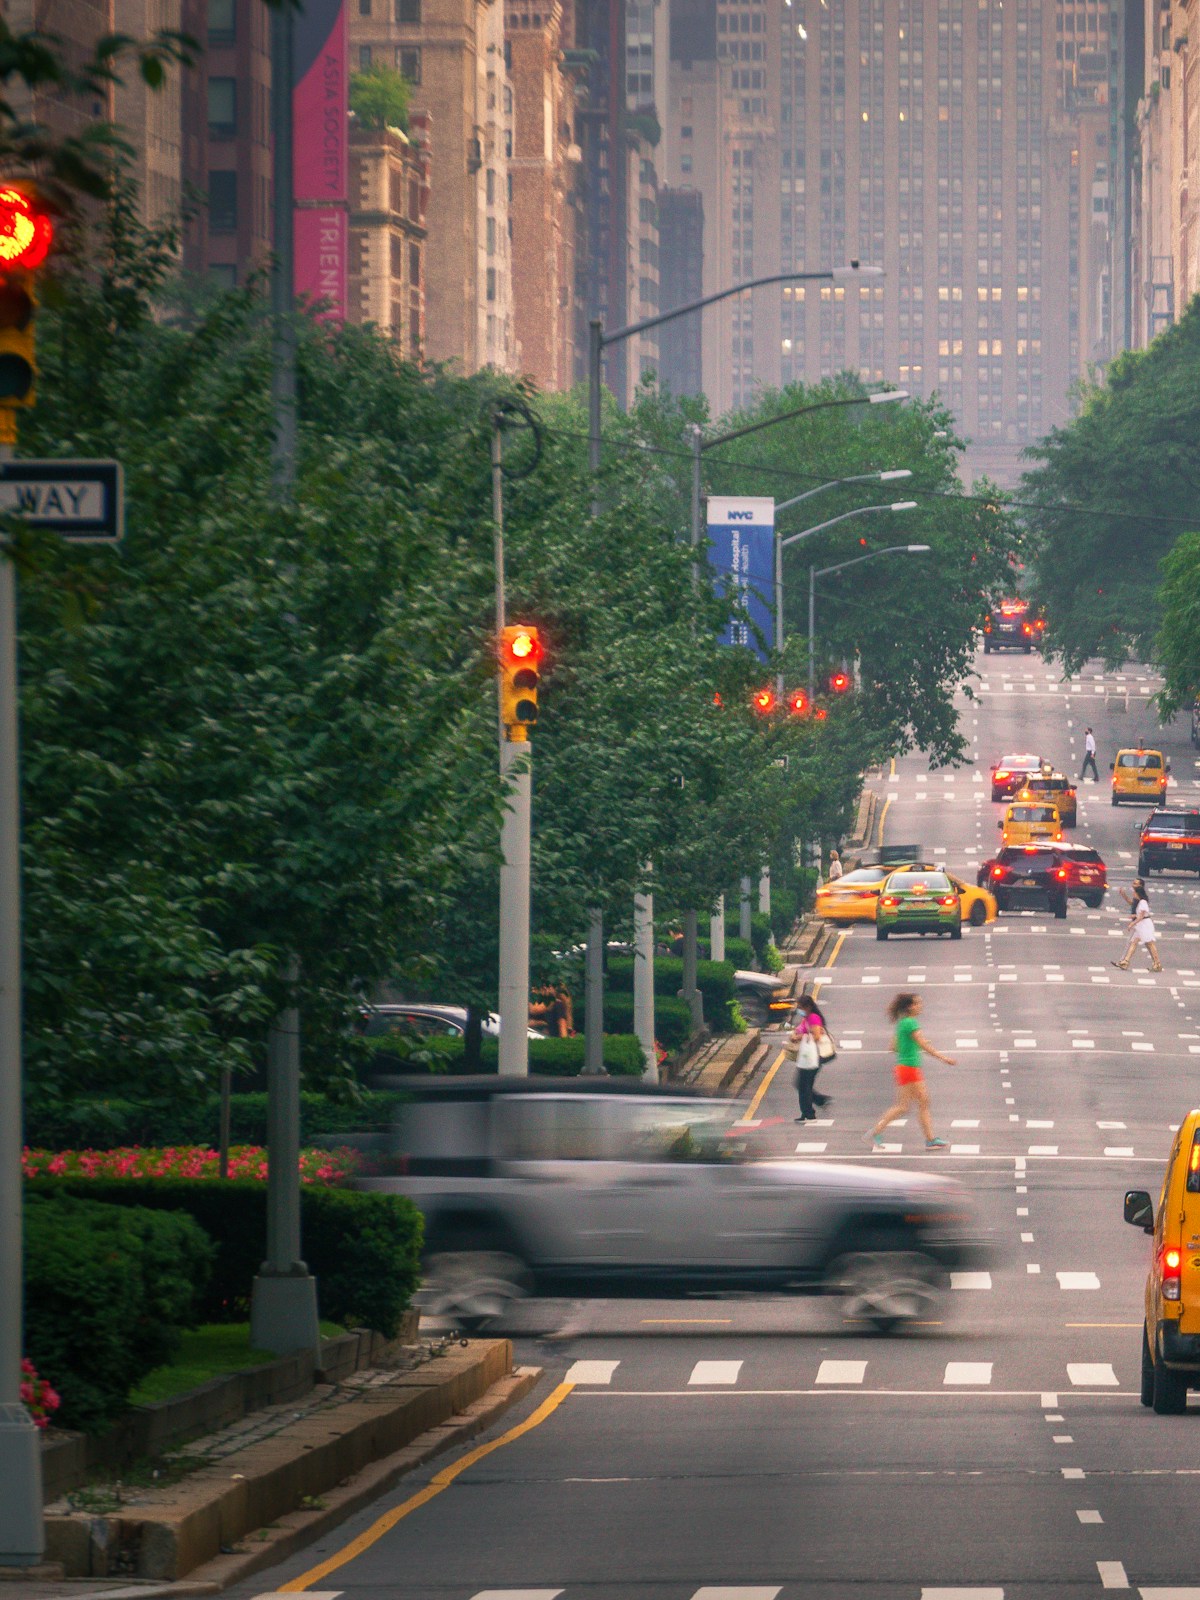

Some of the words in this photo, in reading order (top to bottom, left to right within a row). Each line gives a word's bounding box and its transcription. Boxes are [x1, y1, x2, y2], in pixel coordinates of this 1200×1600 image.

[324, 55, 339, 99] ASIA
[324, 107, 339, 190] SOCIETY
[16, 486, 88, 514] WAY
[727, 510, 753, 520] NYC
